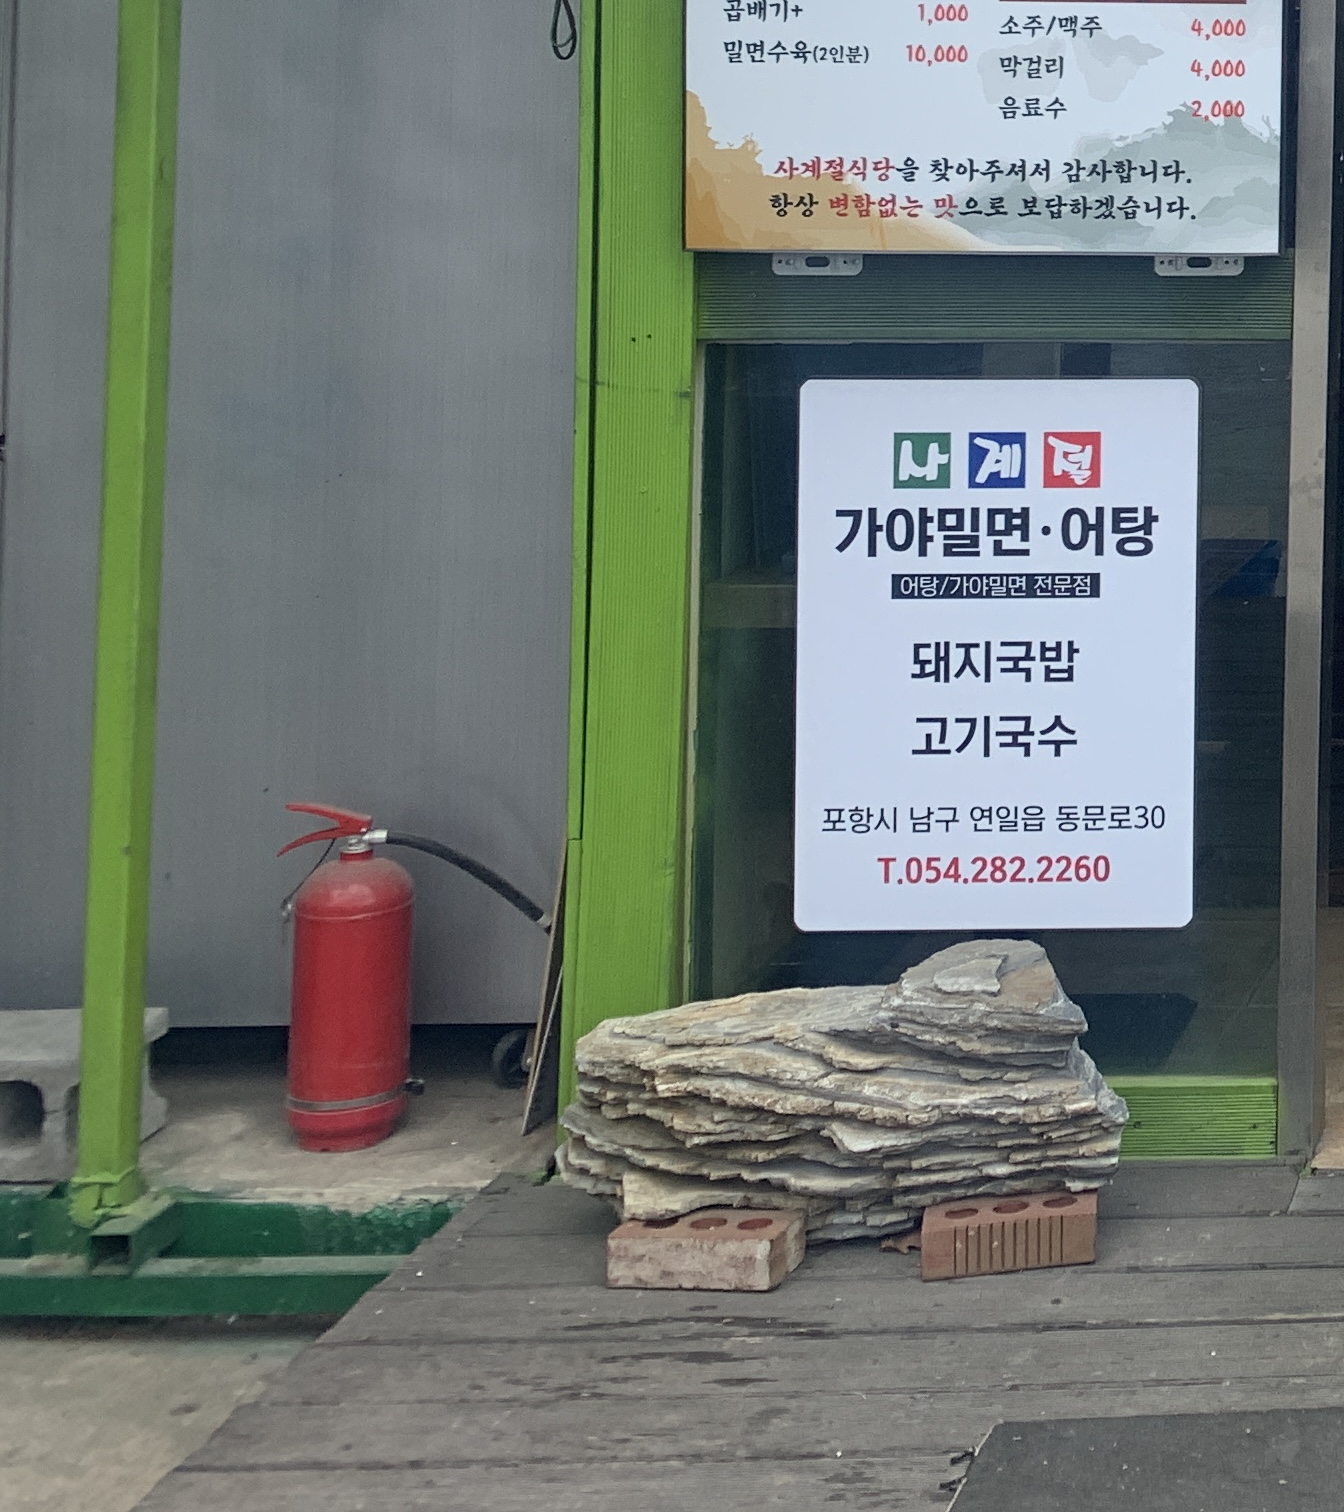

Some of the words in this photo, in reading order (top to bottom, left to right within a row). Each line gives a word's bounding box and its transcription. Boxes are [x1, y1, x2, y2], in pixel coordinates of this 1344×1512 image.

[917, 3, 969, 26] 1,000
[999, 14, 1103, 39] 소주/맥주
[1190, 18, 1247, 41] 4,000
[905, 44, 969, 67] 10,000
[999, 54, 1064, 79] 막걸리
[1190, 58, 1246, 82] 4,000
[998, 95, 1067, 120] 음료수
[1191, 100, 1245, 123] 2,000
[772, 157, 920, 183] 사계절식당을
[928, 157, 1052, 184] 찾아주셔서
[1062, 159, 1193, 186] 감사합니다.
[770, 193, 820, 218] 항상
[828, 194, 924, 219] 변함없는
[933, 196, 1008, 220] 맛으로
[1018, 196, 1198, 222] 보답하겠습니다.
[900, 576, 1026, 597] 어탕/가야밀면
[1033, 575, 1091, 596] 전문점
[910, 640, 1080, 684] 돼지국밥
[911, 714, 1078, 758] 고기국수
[821, 806, 897, 834] 포항시
[909, 806, 960, 833] 남구
[969, 805, 1046, 833] 연일읍
[1055, 805, 1166, 832] 동문로30
[876, 854, 1111, 886] T.054.282.2260
